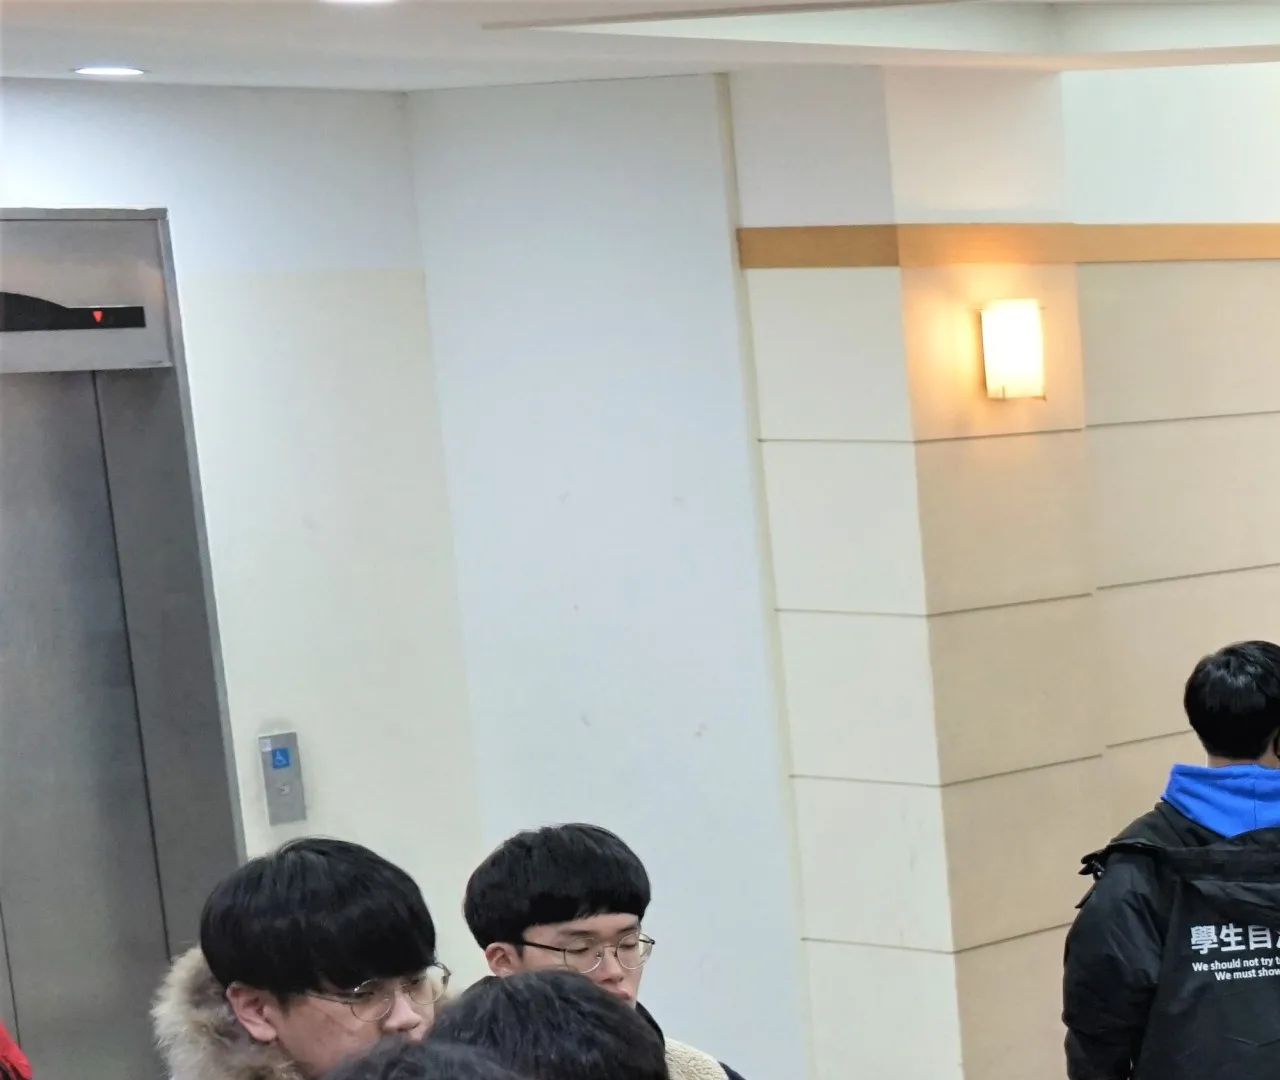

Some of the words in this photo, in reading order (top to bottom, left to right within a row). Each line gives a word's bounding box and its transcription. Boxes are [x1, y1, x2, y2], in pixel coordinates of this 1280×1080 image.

[1192, 962, 1209, 972] We
[1210, 957, 1241, 970] should
[1243, 957, 1259, 967] not
[1261, 957, 1274, 966] try
[1215, 971, 1232, 981] We
[1233, 968, 1257, 979] must
